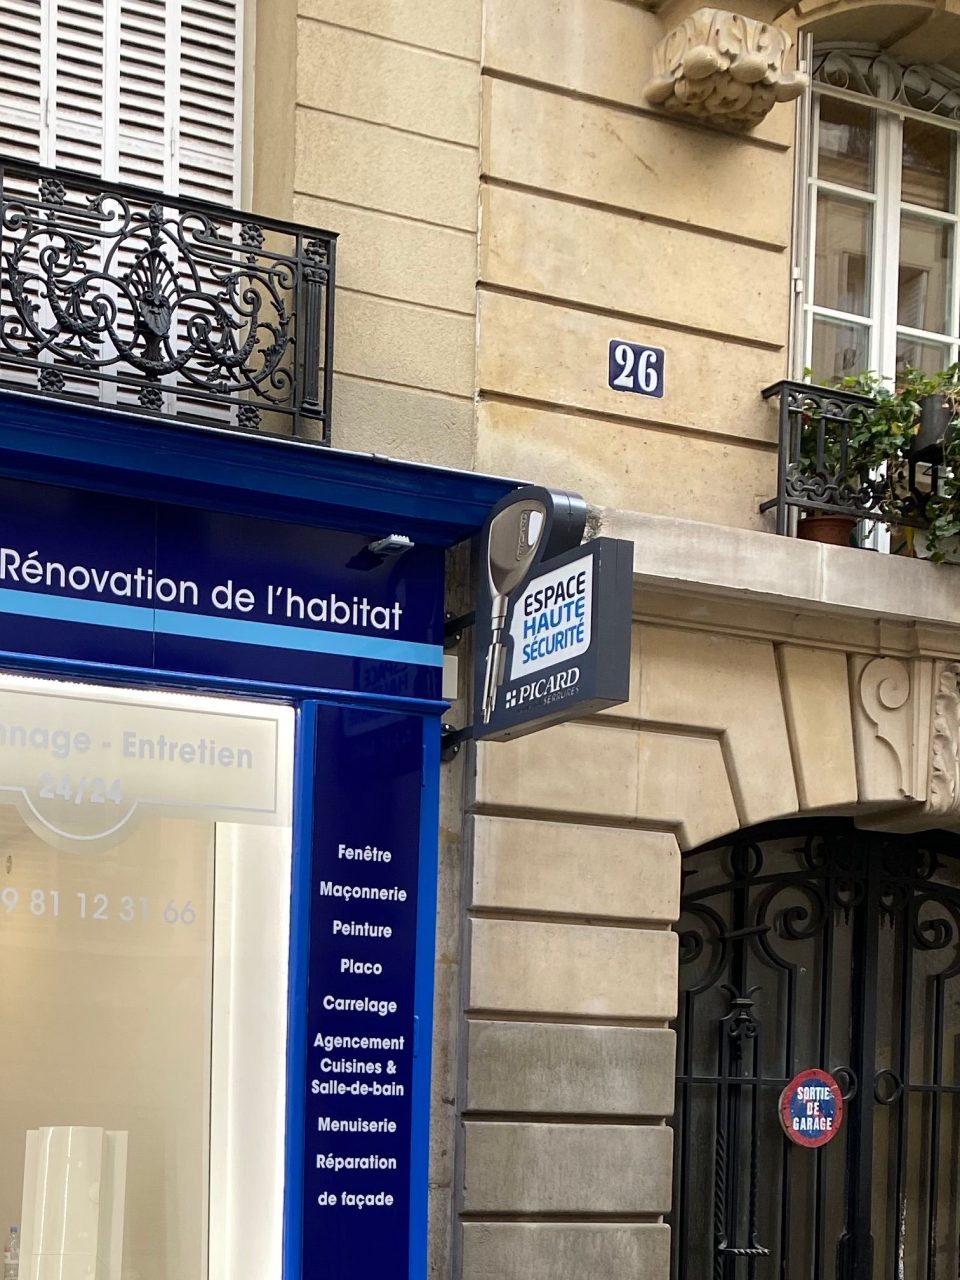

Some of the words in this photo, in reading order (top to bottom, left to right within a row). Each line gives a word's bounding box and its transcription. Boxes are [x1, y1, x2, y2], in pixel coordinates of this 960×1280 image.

[612, 344, 659, 393] 26
[0, 548, 198, 605] Rénovation
[211, 580, 254, 613] de
[523, 570, 587, 618] ESPACE
[522, 595, 586, 641] HAUTE
[522, 620, 585, 665] SÉCURITÉ
[518, 667, 580, 705] PICARD
[122, 731, 254, 769] Entretien
[339, 845, 391, 862] Fenêtre
[320, 881, 406, 901] Maçonnerie
[29, 889, 60, 918] 81
[76, 892, 109, 921] 12
[119, 895, 150, 923] 31
[162, 900, 197, 926] 66
[333, 920, 392, 937] Peinture
[341, 959, 382, 974] Placo
[323, 996, 397, 1016] Carrelage
[314, 1033, 404, 1051] Agencement
[321, 1058, 381, 1073] Cuisines
[387, 1060, 396, 1074] &
[312, 1080, 403, 1095] Salle-de-bain
[797, 1086, 831, 1101] SORTIE
[806, 1102, 820, 1116] DE
[319, 1117, 396, 1132] Menuiserie
[793, 1117, 833, 1131] GARAGE
[317, 1153, 396, 1171] Réparation
[318, 1192, 337, 1205] de
[342, 1192, 393, 1209] façade
